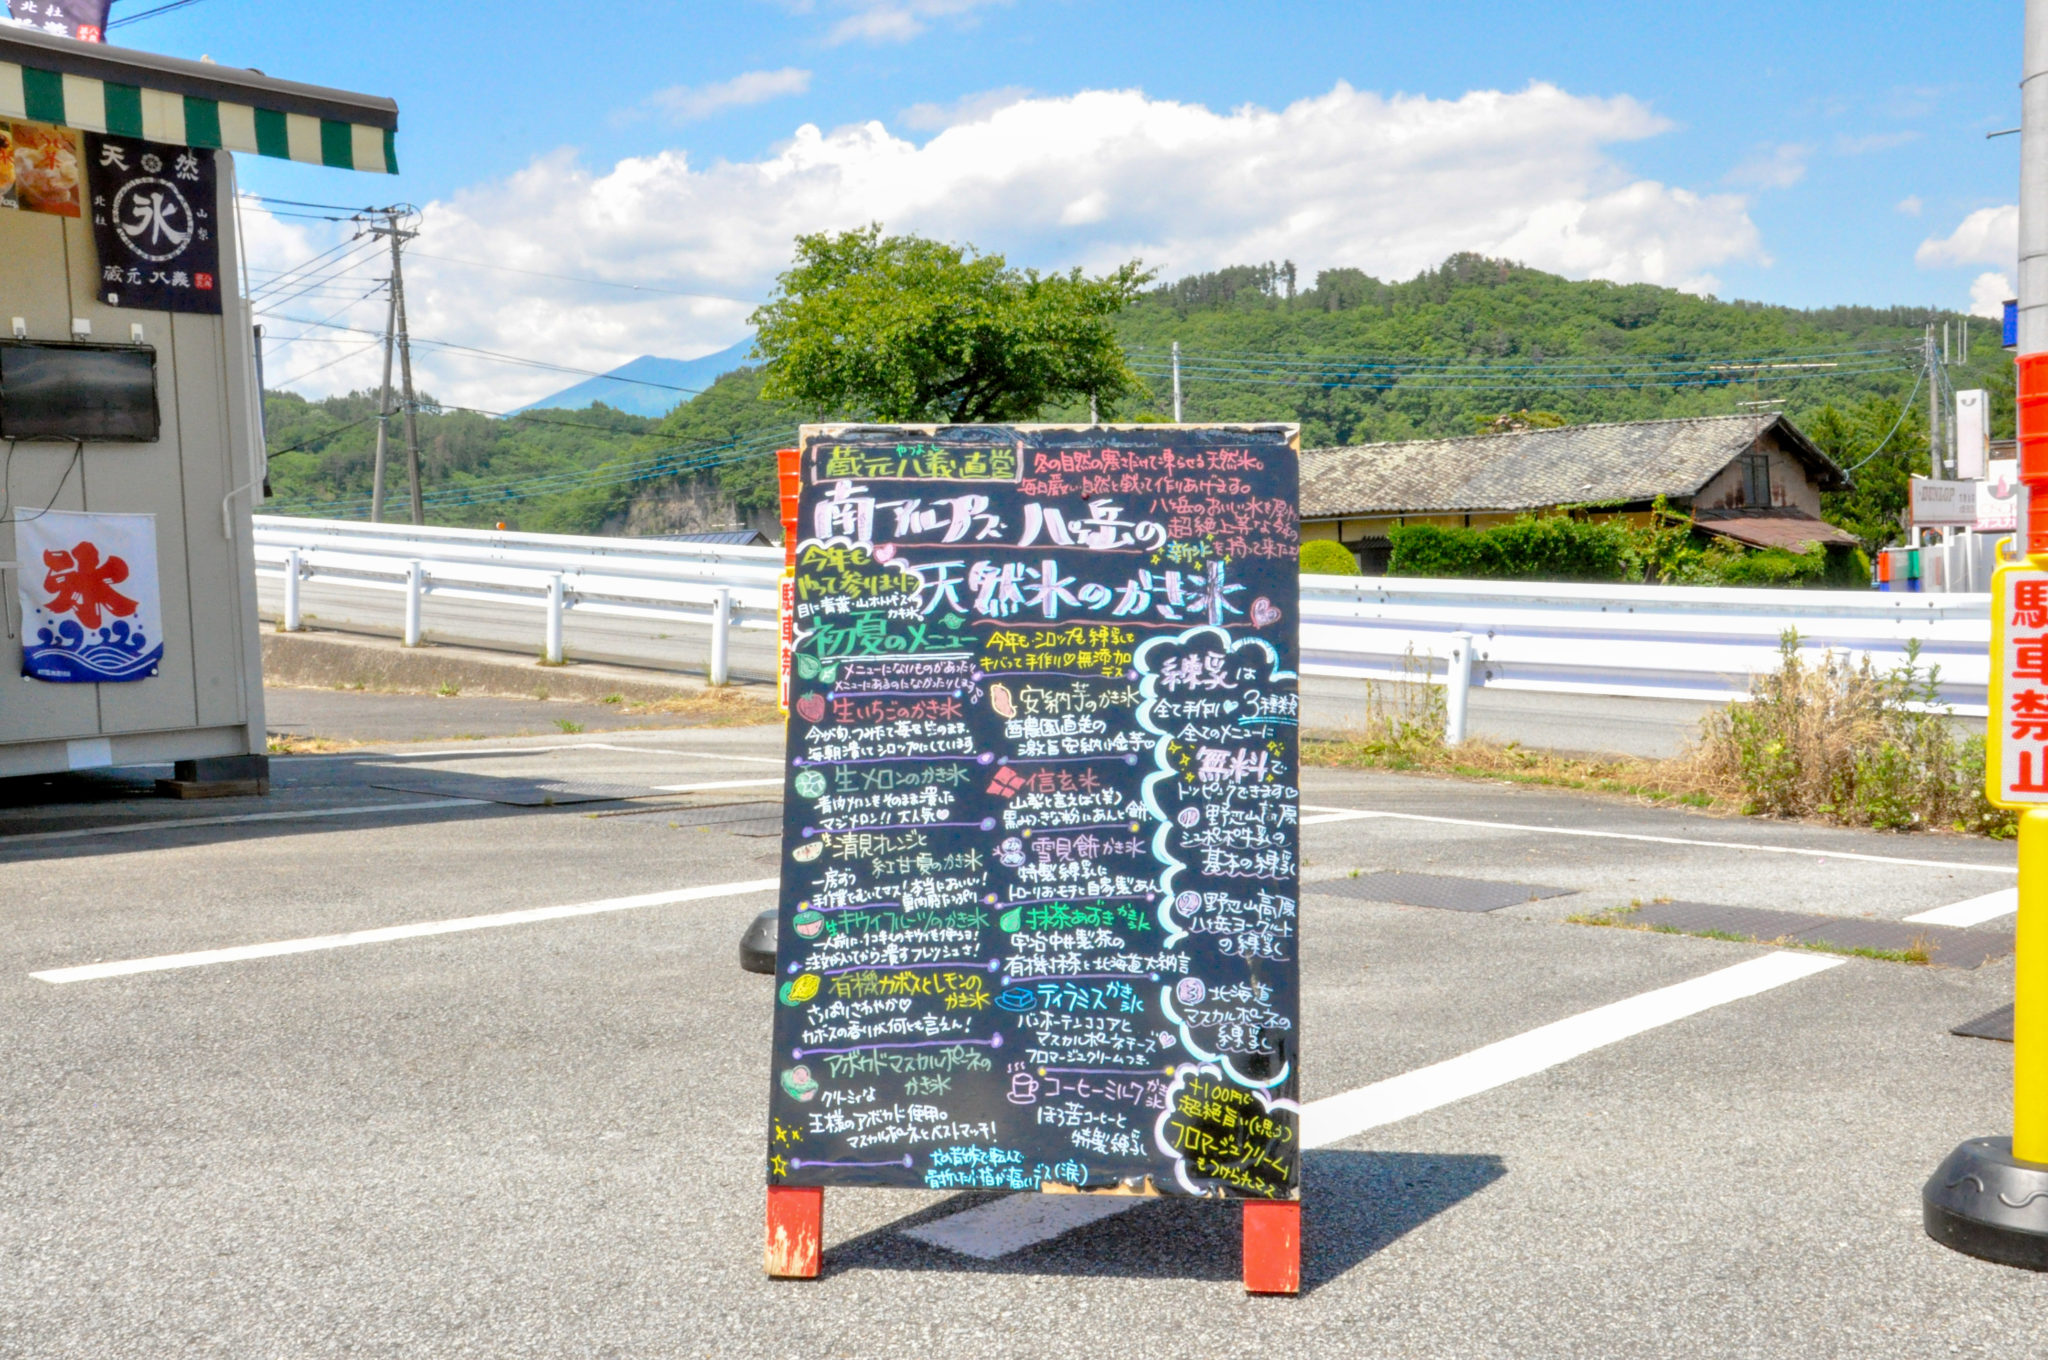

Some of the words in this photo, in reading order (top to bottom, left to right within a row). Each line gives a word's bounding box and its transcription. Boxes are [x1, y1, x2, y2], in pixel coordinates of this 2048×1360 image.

[121, 191, 194, 246] 氷
[43, 541, 140, 630] 氷
[833, 697, 963, 723] 生いちごのかき氷
[835, 763, 970, 793] 生メロンのかき氷
